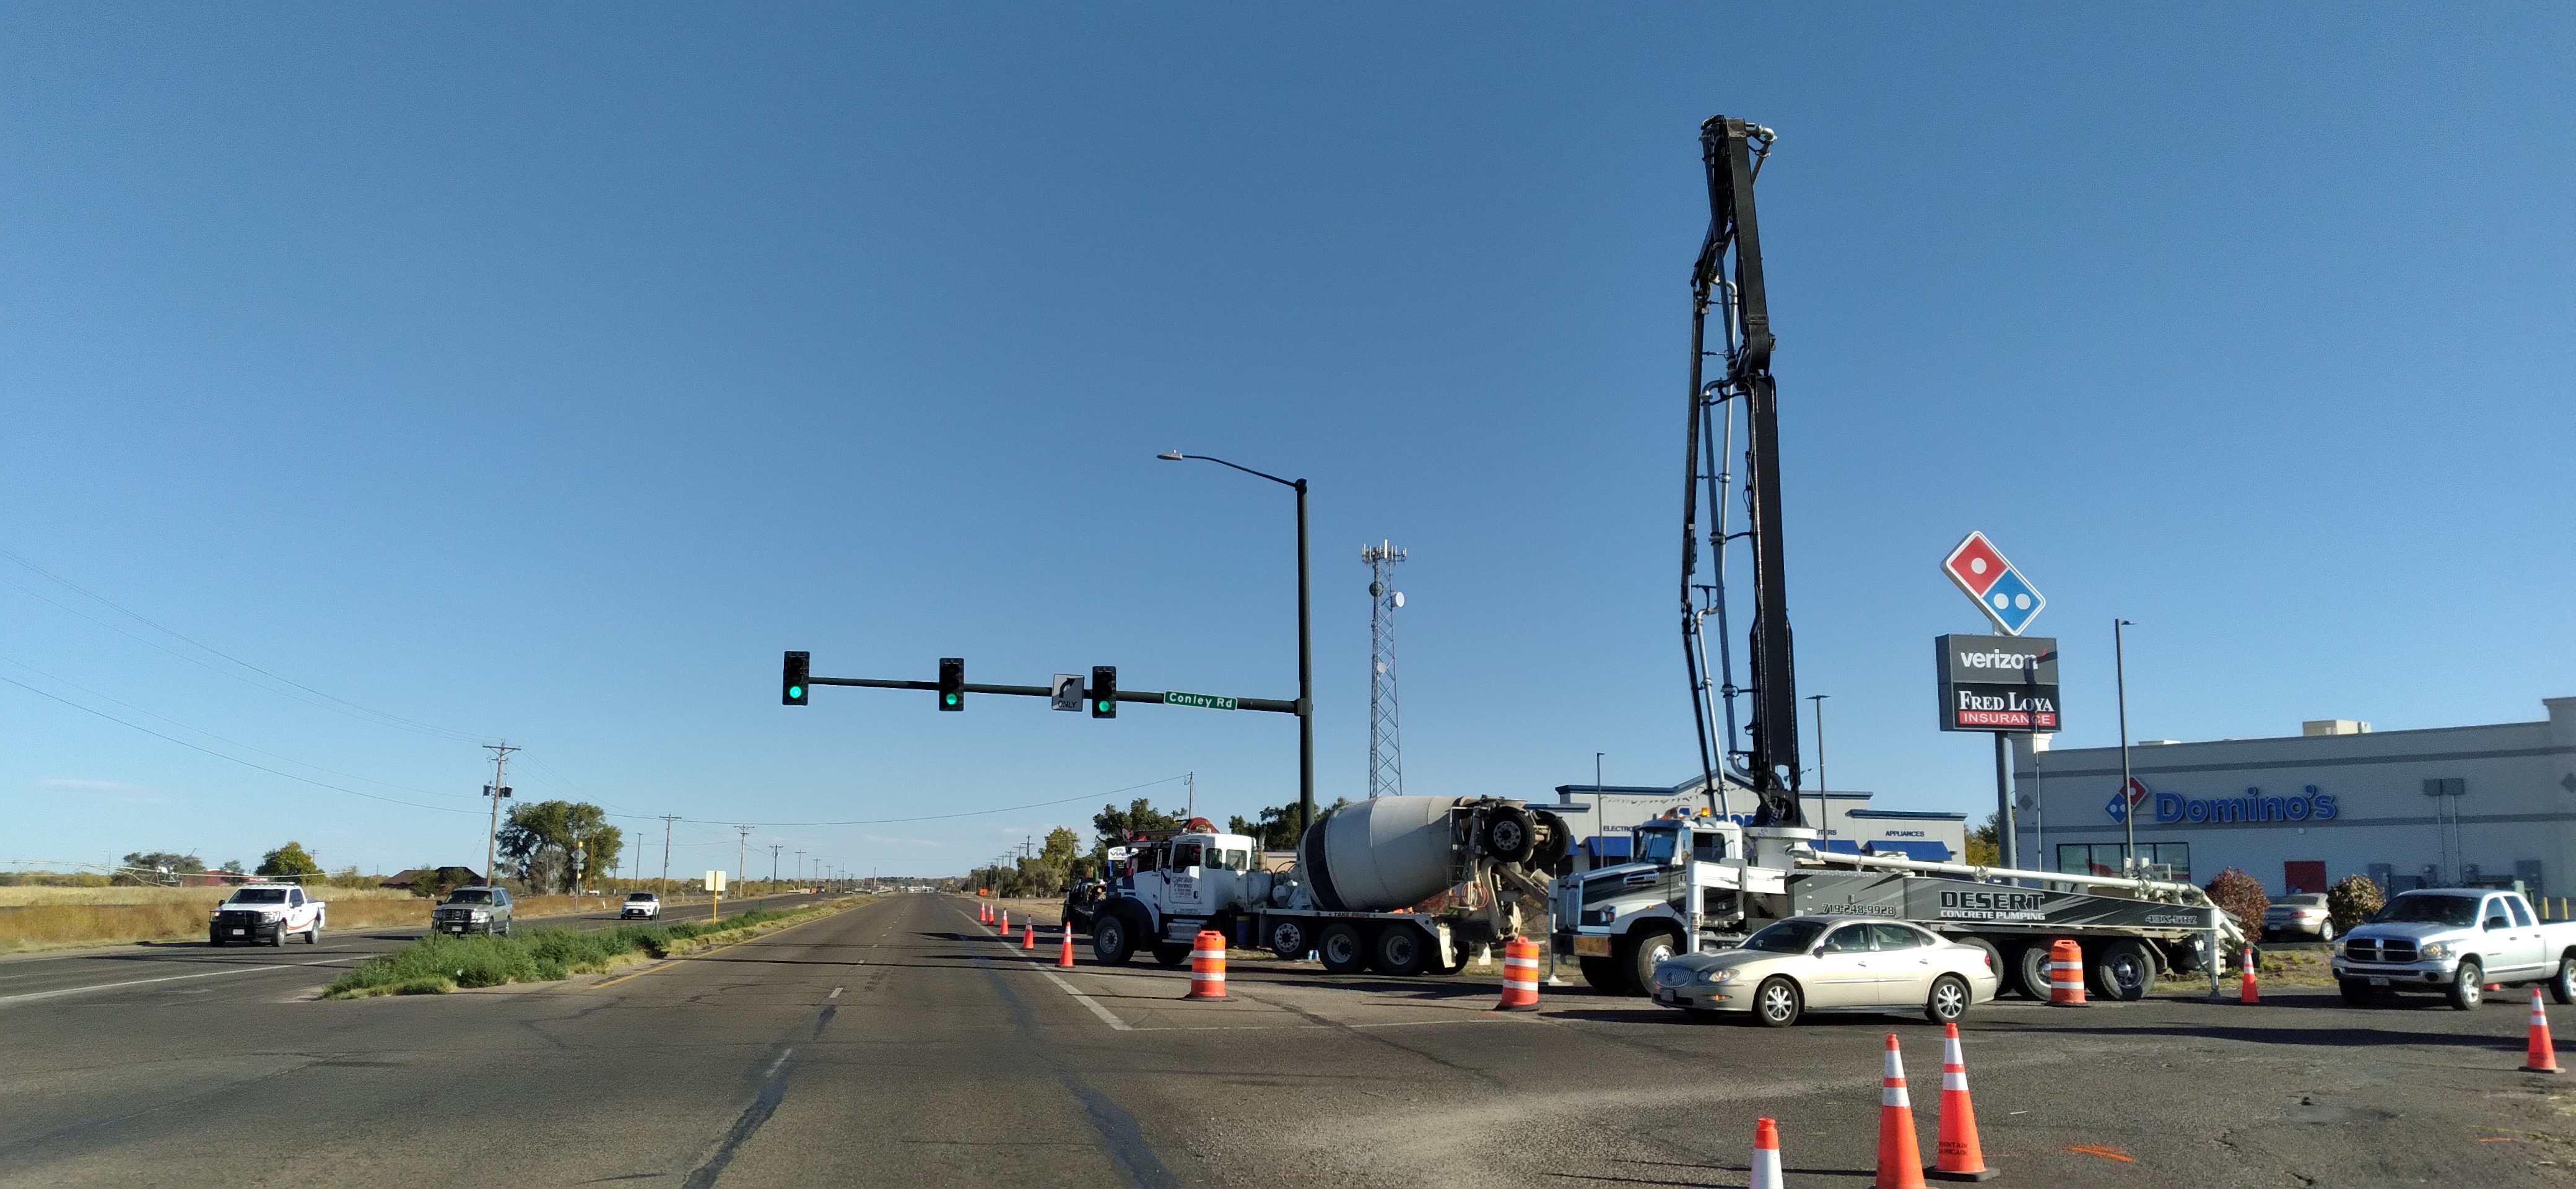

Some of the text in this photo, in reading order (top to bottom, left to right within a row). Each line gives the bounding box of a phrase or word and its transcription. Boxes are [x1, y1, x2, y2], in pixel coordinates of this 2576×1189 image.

[1960, 648, 2039, 669] verizon
[1057, 700, 1077, 708] ONLY
[1168, 692, 1232, 708] Conley Rd
[1958, 690, 2004, 711] FRED
[1964, 712, 2051, 725] INSURANCE
[2156, 784, 2337, 823] Domino's
[1939, 890, 2045, 911] DESERT
[1822, 903, 1896, 915] 719-248-9928
[1940, 910, 2045, 921] CONCRETE PUMPING
